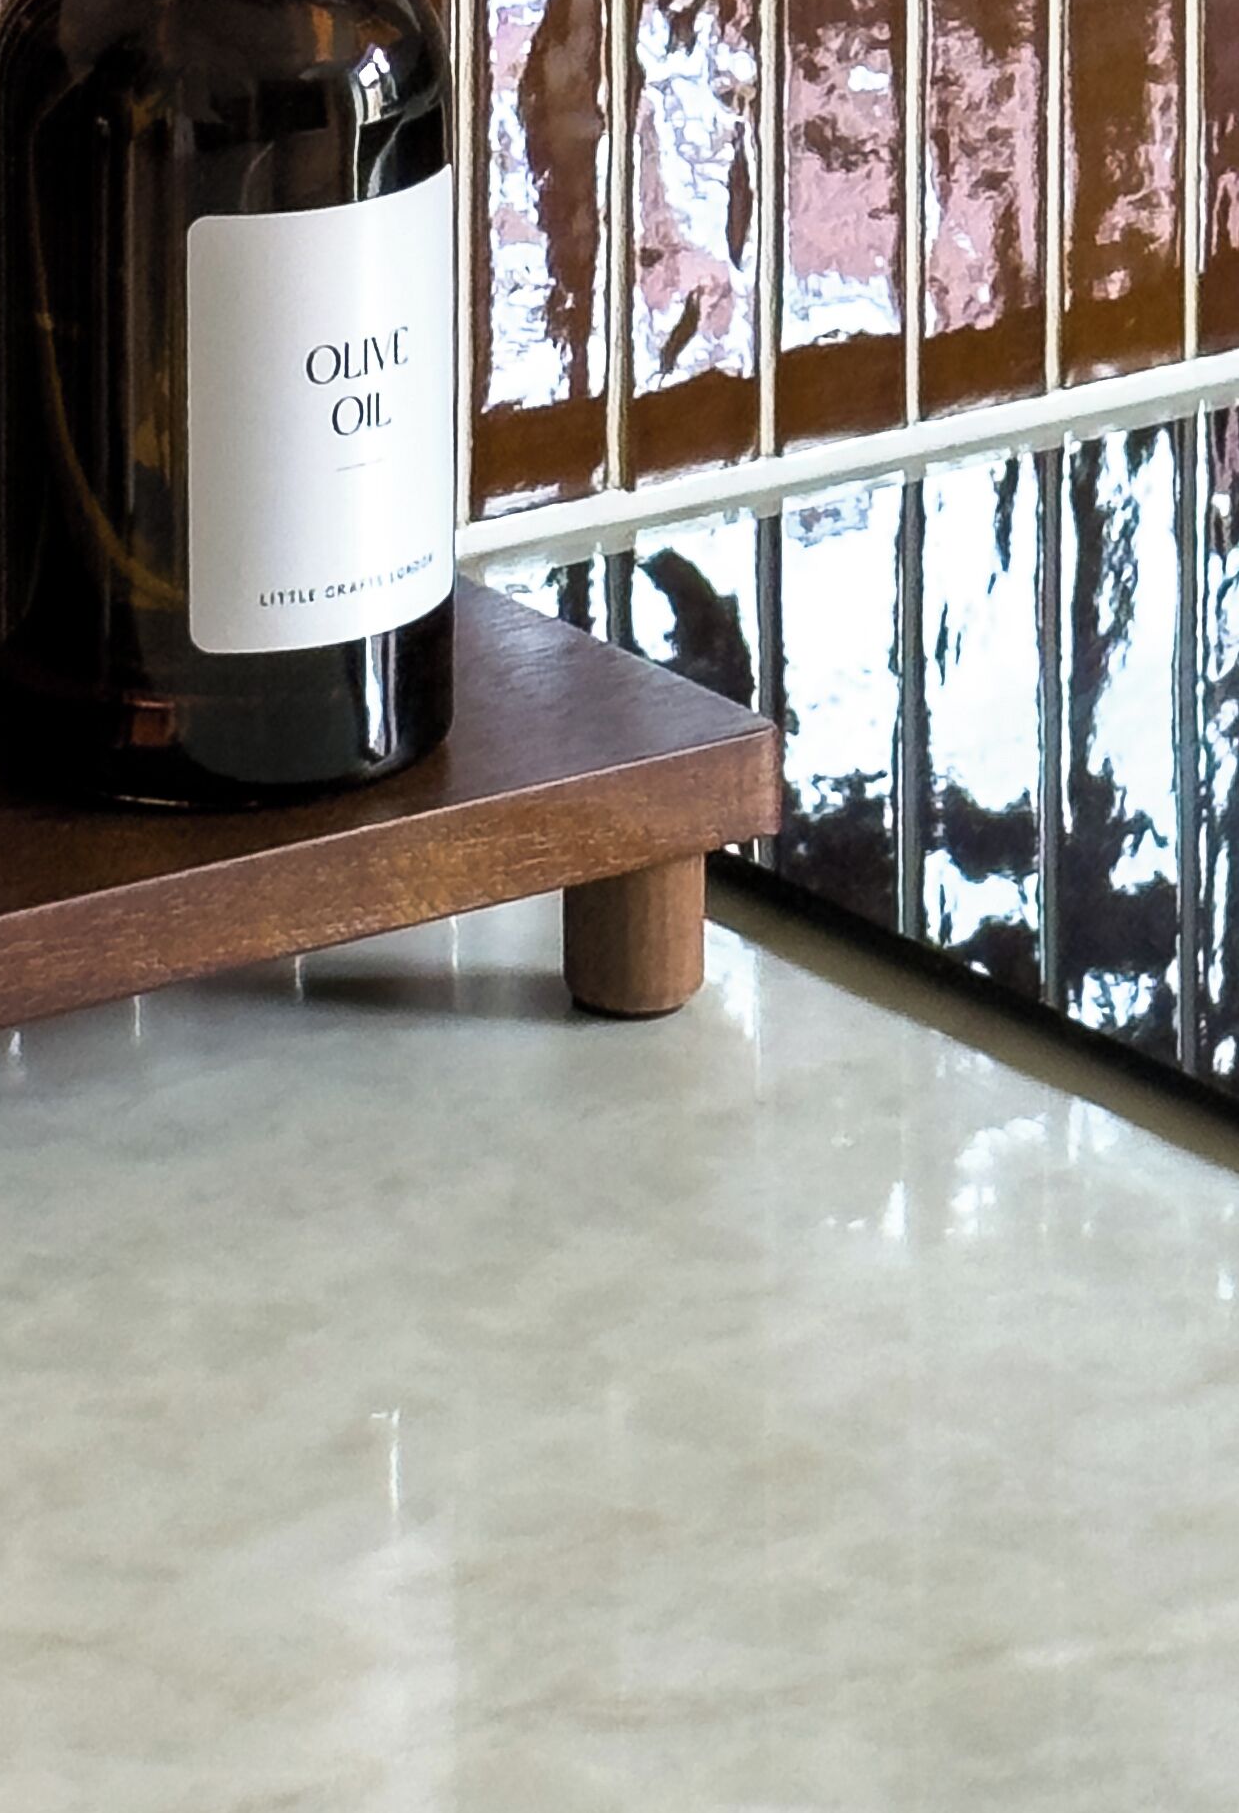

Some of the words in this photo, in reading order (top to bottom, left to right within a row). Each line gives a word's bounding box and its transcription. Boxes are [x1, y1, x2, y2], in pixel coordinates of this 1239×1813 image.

[306, 326, 408, 385] OLIVE
[332, 392, 391, 436] OIL
[259, 588, 315, 607] LITTLE
